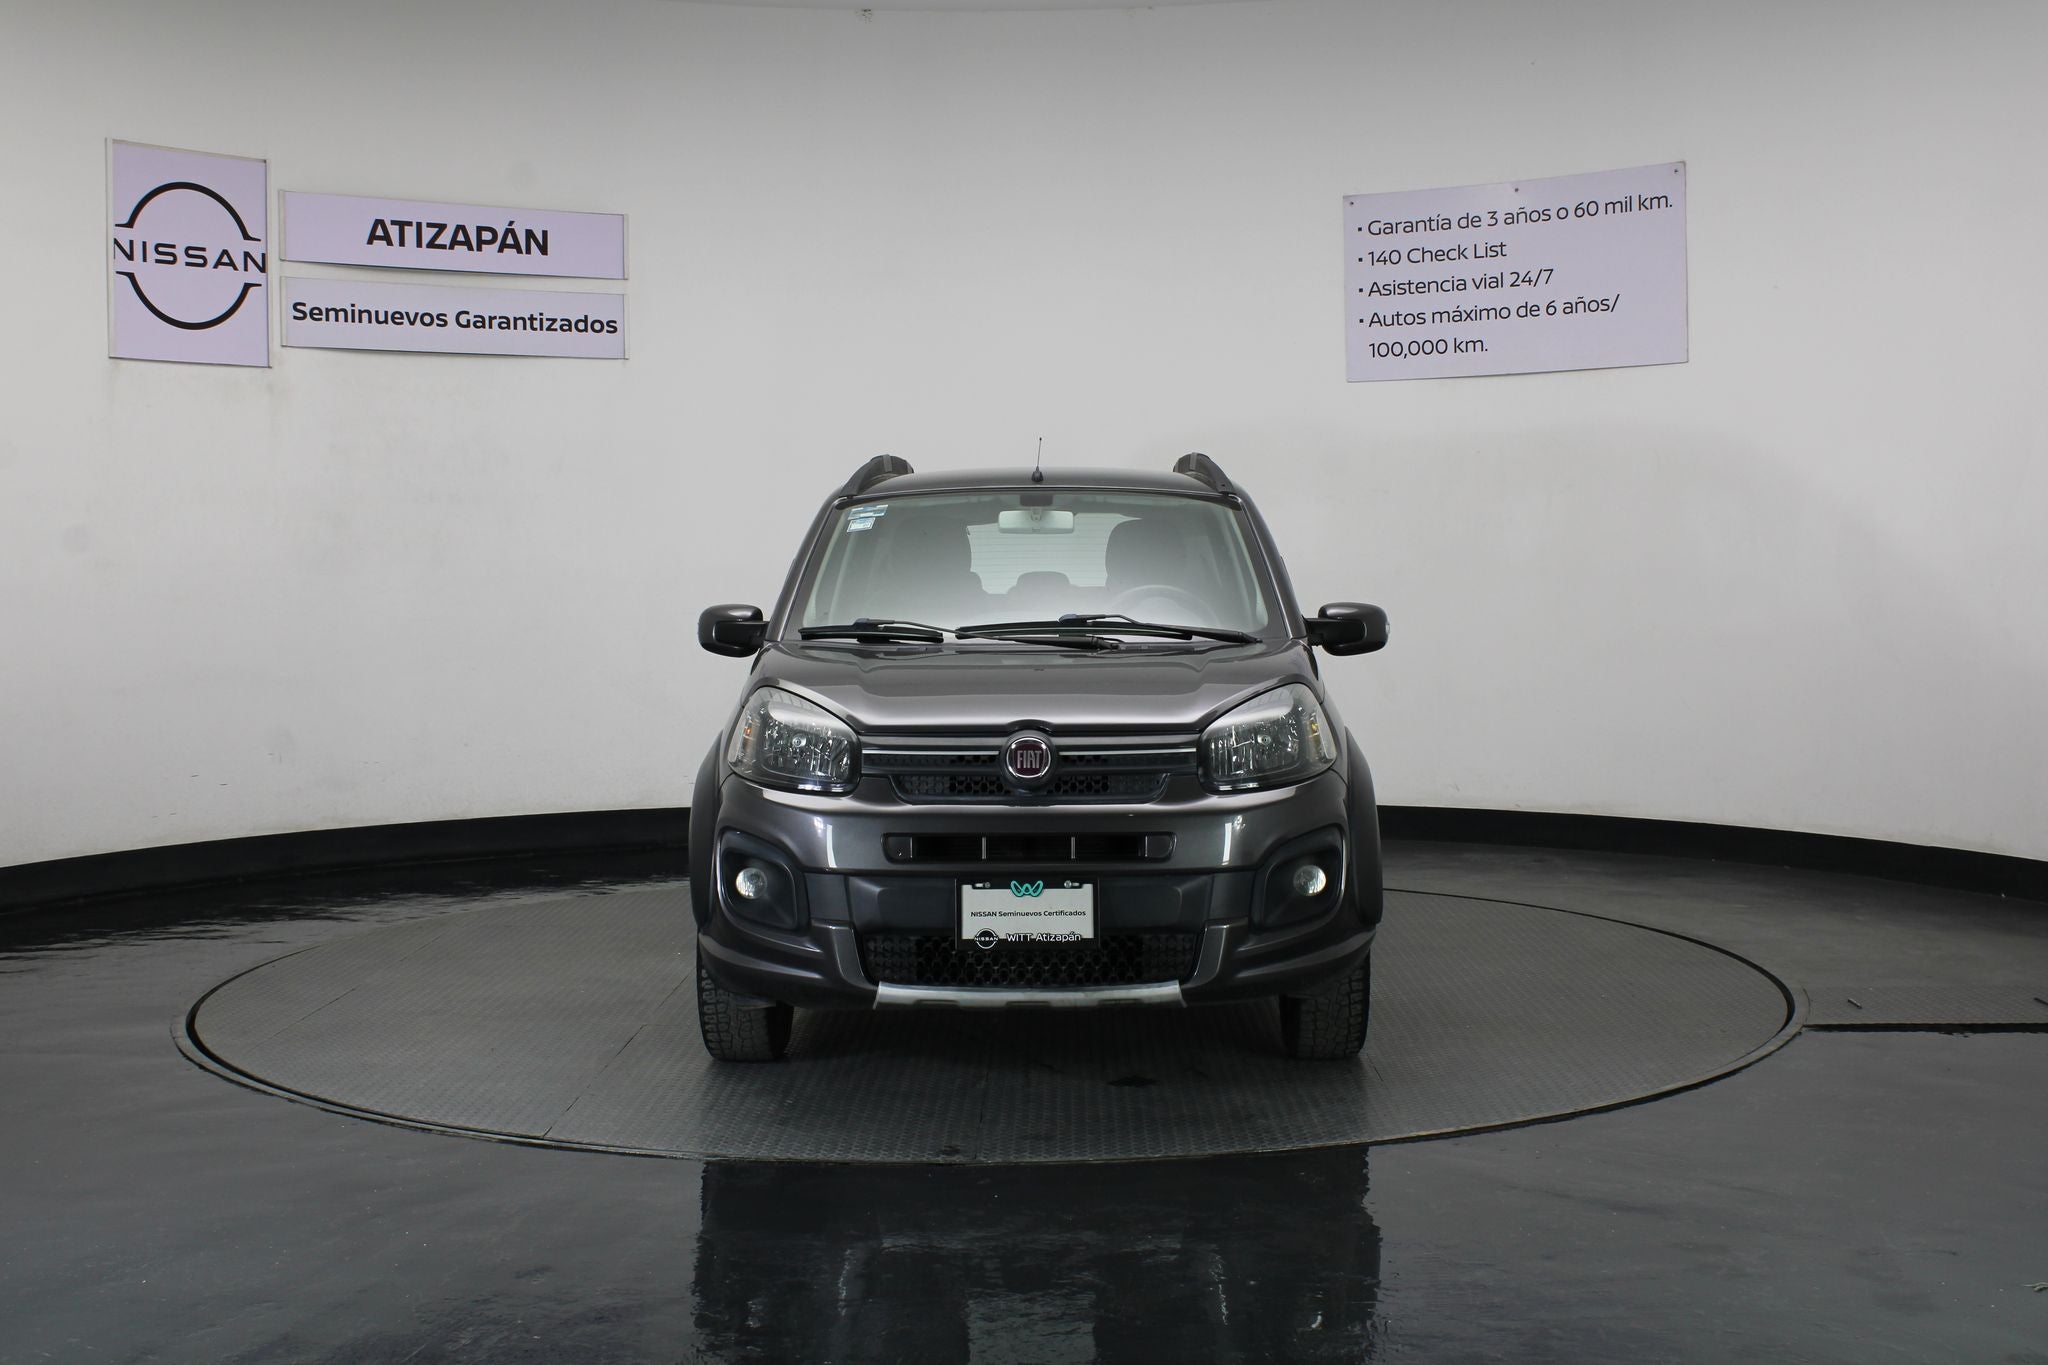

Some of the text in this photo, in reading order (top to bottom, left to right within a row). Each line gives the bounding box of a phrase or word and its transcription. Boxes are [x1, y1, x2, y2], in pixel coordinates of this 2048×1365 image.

[1367, 193, 1674, 237] Garantía de 3 años o 60 mil km.
[366, 219, 550, 257] ATIZAPÁN
[113, 237, 267, 275] NISSAN
[1367, 241, 1508, 267] 140 Check List
[1367, 268, 1555, 298] Asistencia vial 24/7
[292, 301, 618, 335] Seminuevos Garantizados
[1368, 294, 1621, 329] Autos máximo de 6 años/
[1368, 337, 1489, 360] 100,000 km.
[1017, 750, 1042, 769] FIAT
[970, 910, 998, 918] NISSAN
[1043, 909, 1087, 917] Certificados
[1006, 931, 1081, 943] WITT Atizapán
